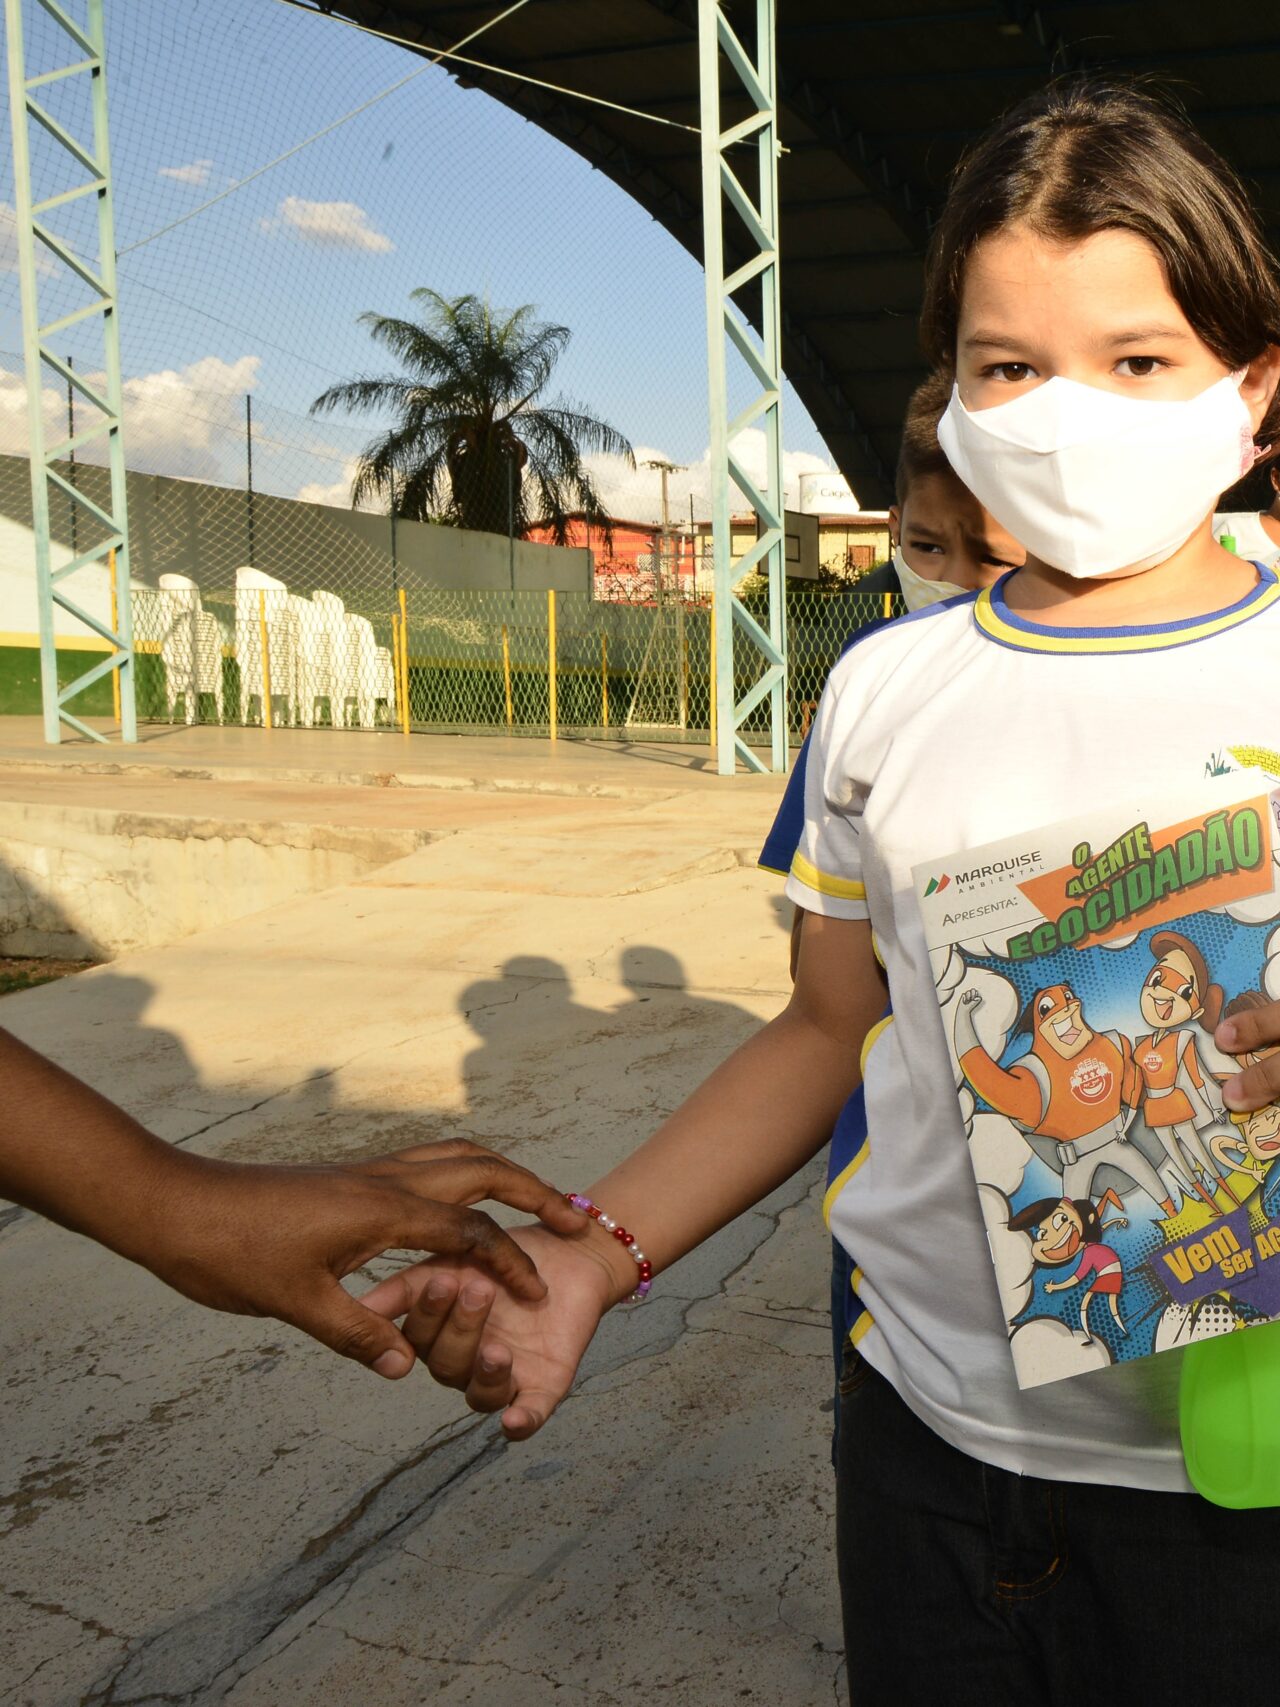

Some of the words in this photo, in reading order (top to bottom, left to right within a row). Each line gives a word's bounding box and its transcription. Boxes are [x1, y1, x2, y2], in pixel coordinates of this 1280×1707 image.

[955, 850, 1042, 885] MARQUISE
[1065, 822, 1151, 898] AGENTE
[1072, 841, 1091, 869] O
[958, 864, 1045, 894] AMBIENTAL
[1007, 807, 1261, 961] ECOCIDADÃO
[1162, 1224, 1241, 1285] Vem
[1219, 1248, 1255, 1279] ser
